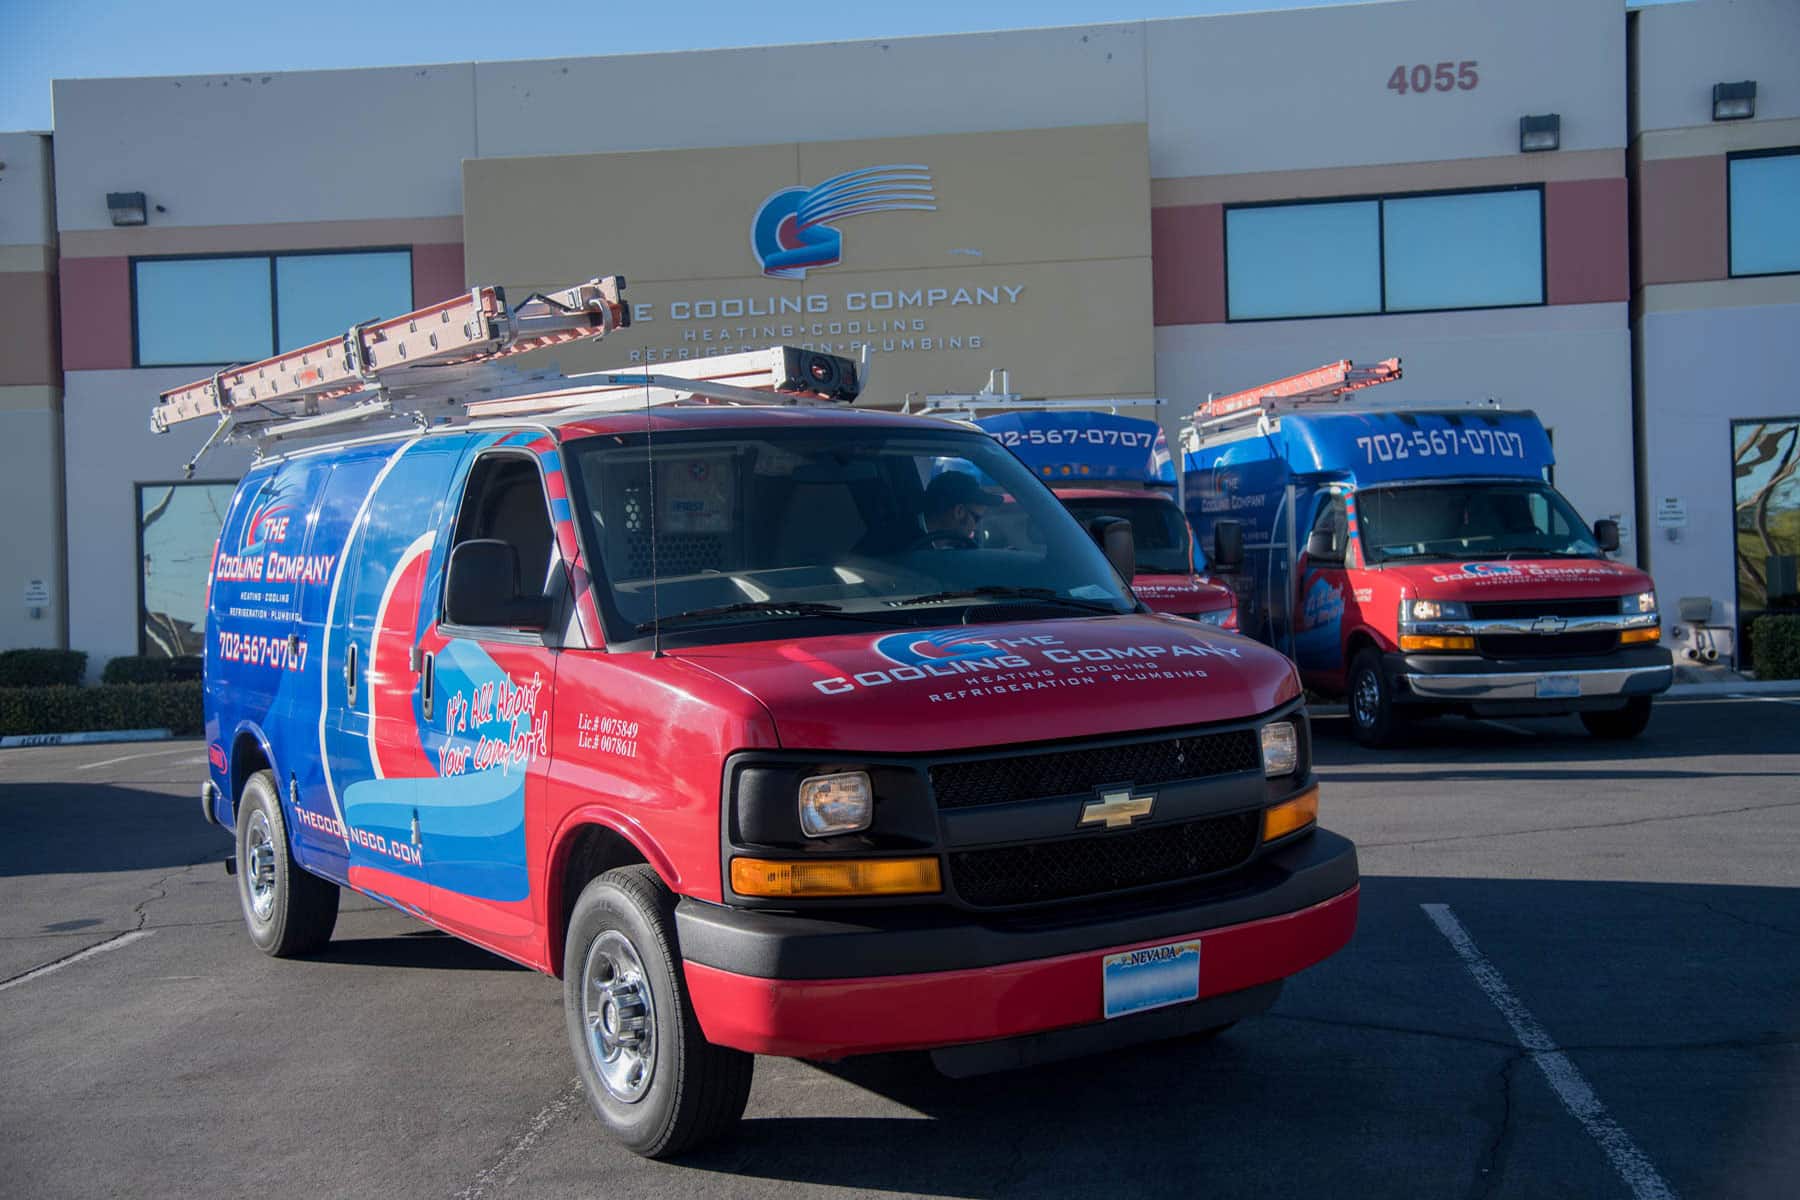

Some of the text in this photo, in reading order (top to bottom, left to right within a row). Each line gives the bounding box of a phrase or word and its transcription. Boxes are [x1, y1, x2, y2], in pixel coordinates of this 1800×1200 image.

[1387, 61, 1479, 95] 4055
[671, 294, 829, 321] COOLING
[846, 285, 1025, 312] COMPANY
[263, 516, 290, 542] THE
[216, 551, 336, 584] COOLING COMPANY
[972, 635, 1065, 649] THE
[812, 644, 1242, 696] COOLING COMPANY
[928, 669, 1209, 703] REFRIGERATION PLUMBING
[965, 662, 1159, 686] HEATING COOLING
[446, 672, 543, 735] It's All About
[601, 716, 639, 738] 0075849
[438, 711, 548, 777] Your Comfort!
[601, 735, 638, 758] 0078611
[1131, 946, 1176, 965] NEVADA
